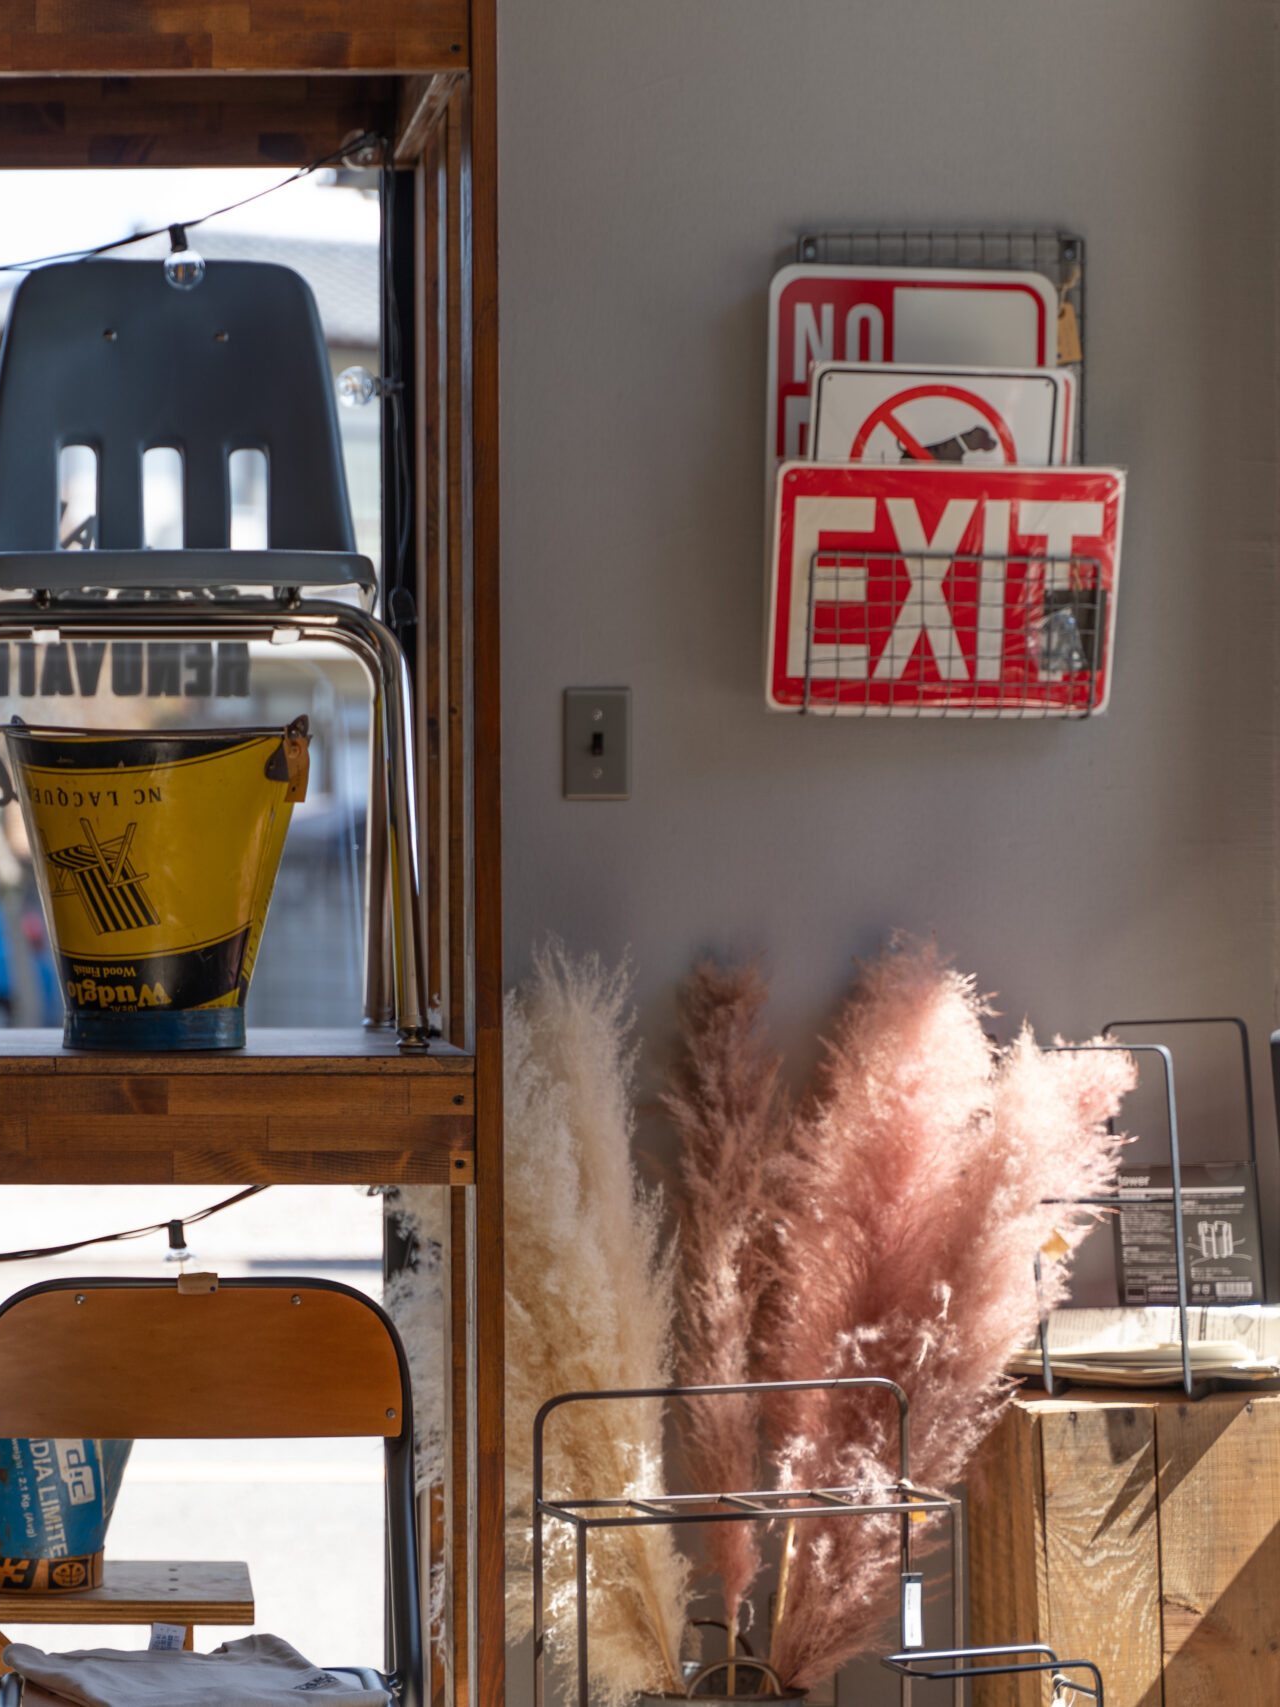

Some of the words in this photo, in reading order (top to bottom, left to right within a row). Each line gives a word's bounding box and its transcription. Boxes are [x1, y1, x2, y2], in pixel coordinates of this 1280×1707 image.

[786, 496, 1105, 682] EXIT
[133, 787, 162, 805] NC
[73, 965, 100, 977] Finish
[104, 965, 137, 977] Wood
[67, 979, 173, 1008] Wudglo
